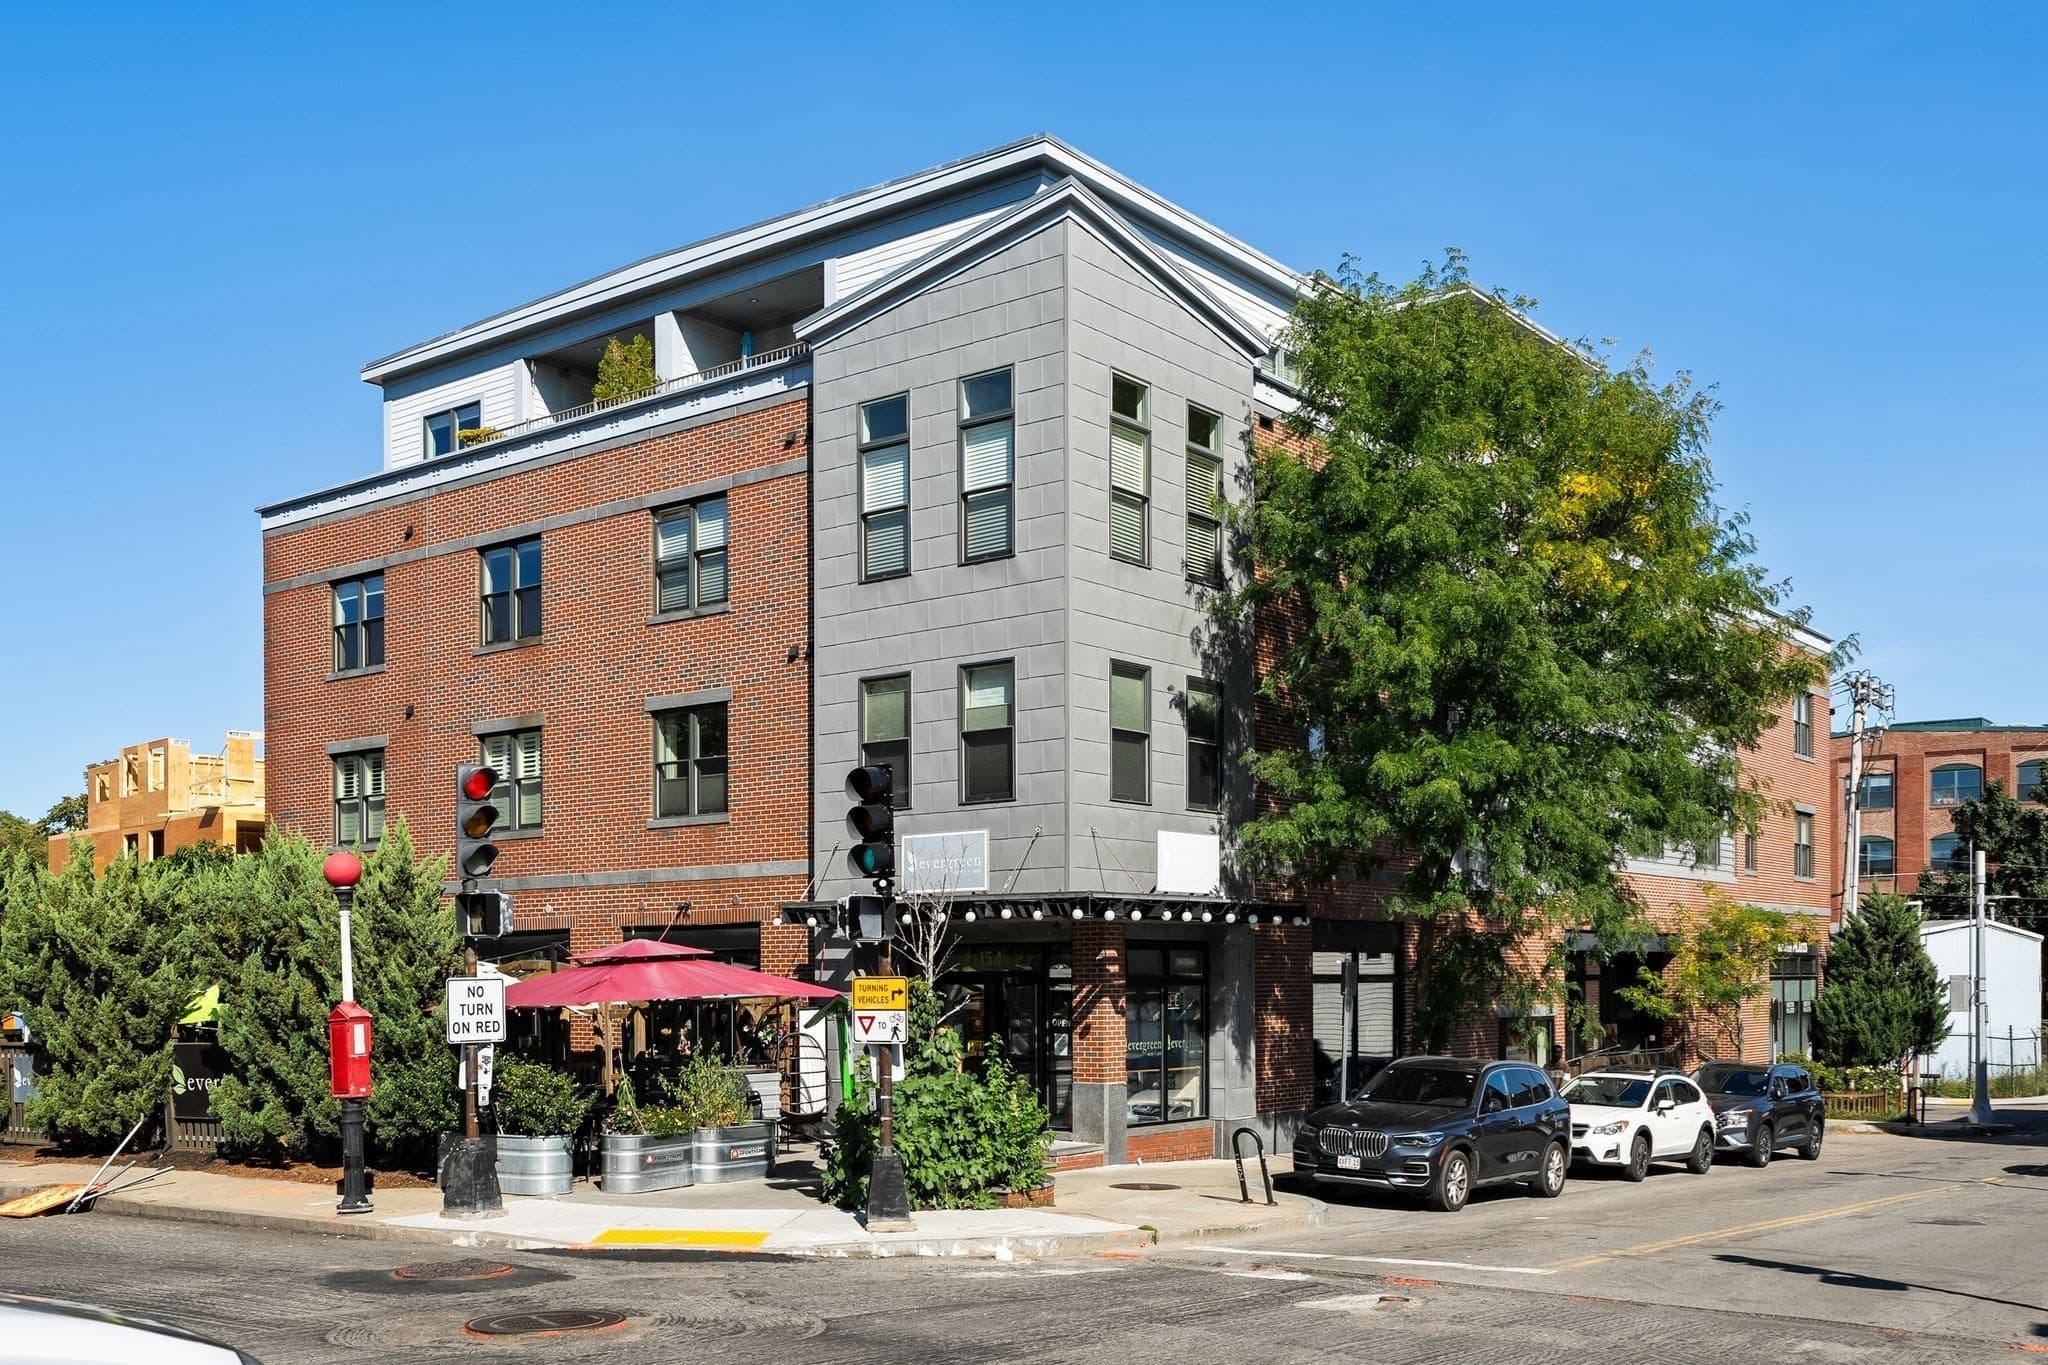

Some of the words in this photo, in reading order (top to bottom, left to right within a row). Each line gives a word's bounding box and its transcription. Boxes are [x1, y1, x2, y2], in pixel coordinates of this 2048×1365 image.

[919, 856, 982, 873] evergreen
[467, 986, 484, 998] NO
[859, 984, 889, 993] TURNING
[858, 995, 889, 1004] VEHICLES
[459, 1003, 493, 1016] TURN
[452, 1021, 470, 1034] ON
[476, 1020, 500, 1033] RED
[878, 1021, 887, 1030] TO
[1051, 1018, 1071, 1028] OPEN
[1127, 1040, 1163, 1054] evergreen
[187, 1077, 224, 1091] ever
